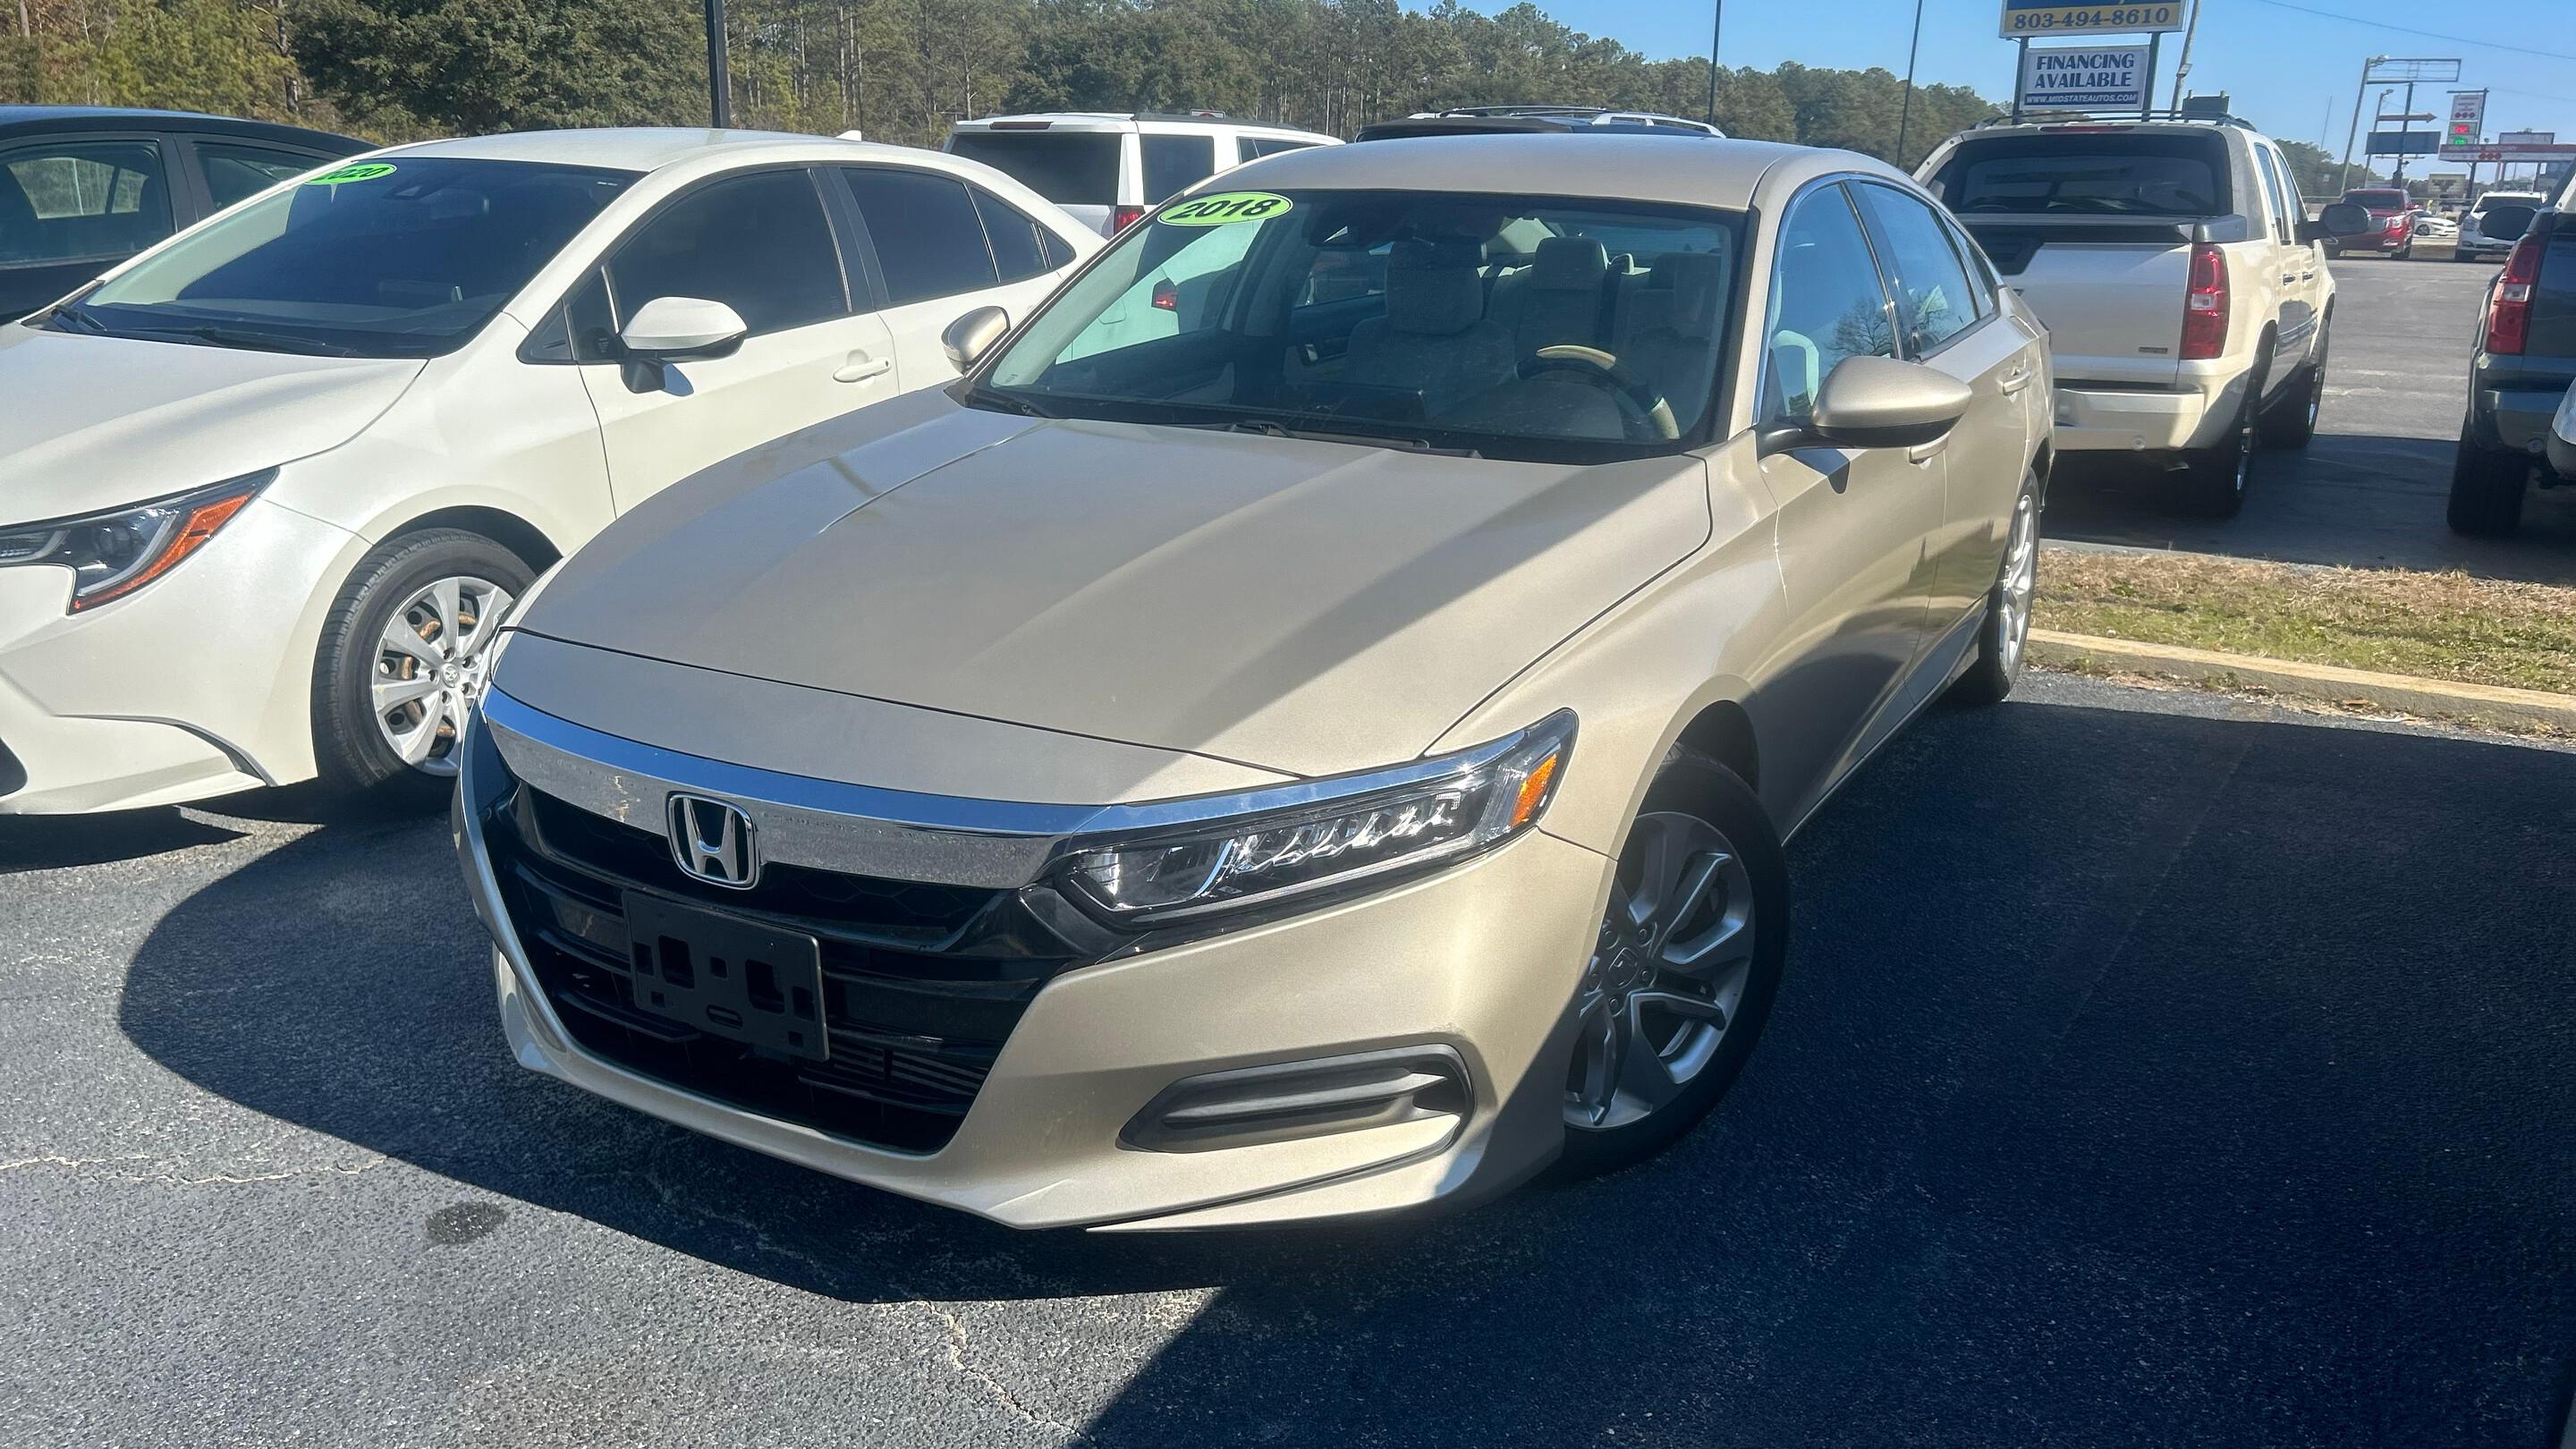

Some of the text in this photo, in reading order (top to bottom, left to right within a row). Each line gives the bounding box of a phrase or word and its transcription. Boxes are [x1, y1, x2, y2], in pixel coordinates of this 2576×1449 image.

[2013, 7, 2170, 30] 803-494-8610
[2037, 53, 2135, 71] FINANCING
[2034, 72, 2132, 89] AVAILABLE
[1166, 199, 1281, 221] 2018
